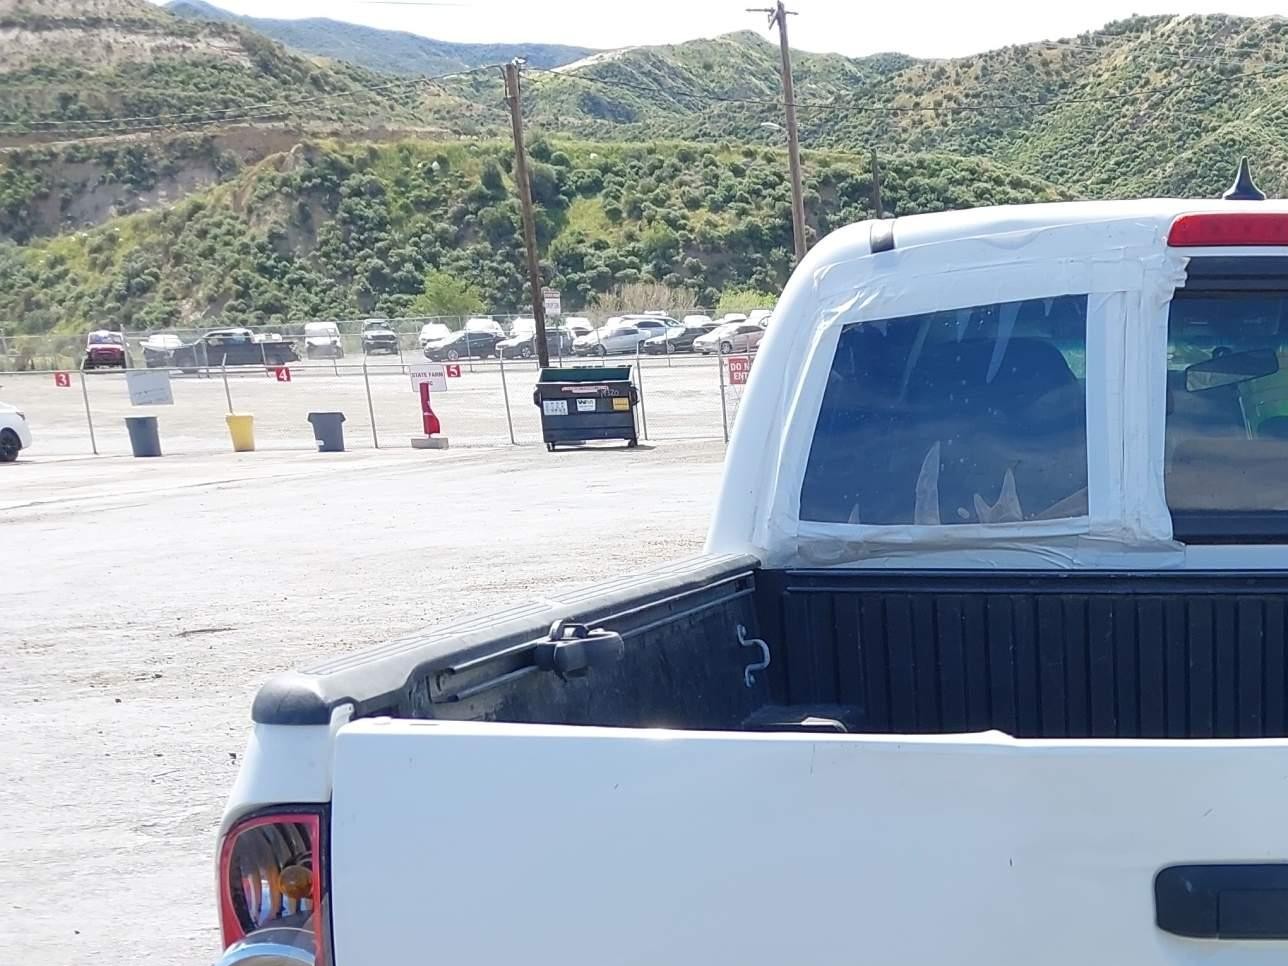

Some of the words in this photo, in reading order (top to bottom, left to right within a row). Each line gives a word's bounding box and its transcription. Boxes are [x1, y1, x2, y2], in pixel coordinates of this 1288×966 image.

[278, 368, 288, 381] 4
[449, 365, 458, 377] 5
[59, 373, 67, 386] 3
